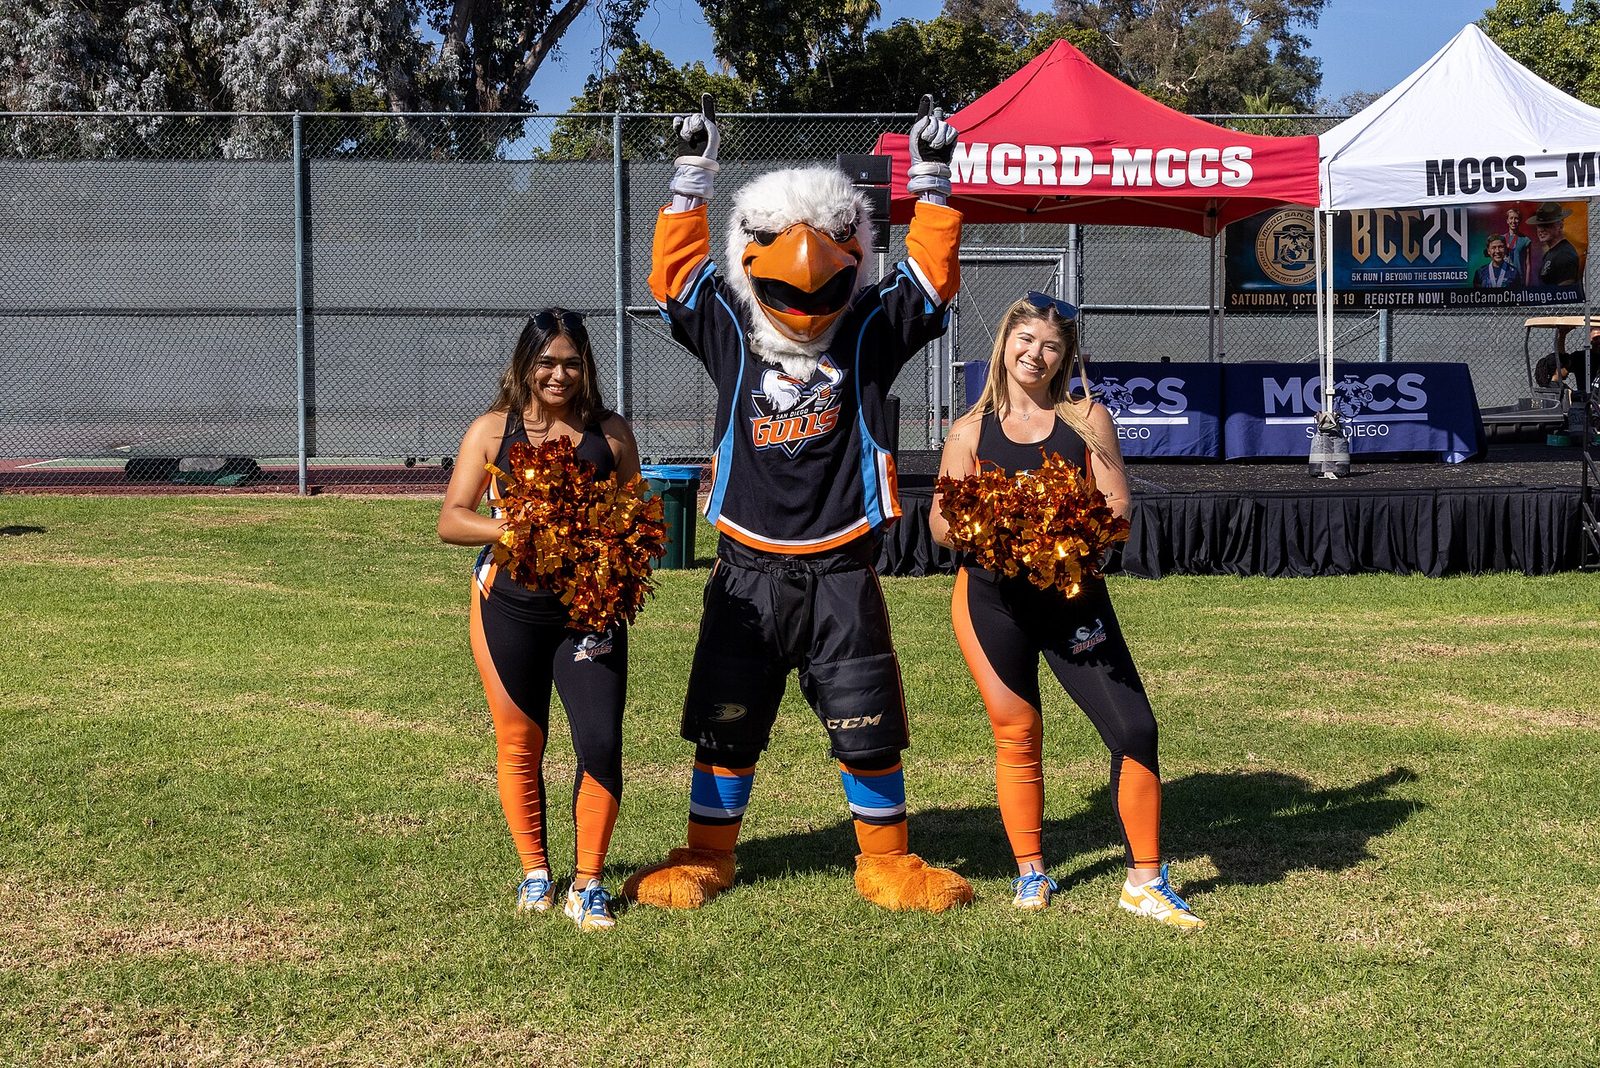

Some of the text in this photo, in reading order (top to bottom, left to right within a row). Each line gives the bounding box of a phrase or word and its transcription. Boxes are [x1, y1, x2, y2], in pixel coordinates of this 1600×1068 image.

[950, 142, 1253, 187] MCRD-MCCS
[1426, 155, 1527, 196] MCCS
[1566, 152, 1600, 188] M
[1270, 271, 1291, 282] CAMP
[1352, 273, 1361, 281] 5K
[1363, 273, 1378, 281] RUN
[1385, 273, 1413, 281] BEYOND
[1414, 272, 1427, 280] THE
[1428, 271, 1468, 280] OBSTACLES
[1231, 290, 1578, 306] SATURDAY, OCTOBR 19 REGISTER NOW! BootCampChallenge.com
[789, 408, 809, 418] DIEGO
[749, 405, 841, 448] GULLS
[826, 712, 884, 730] CCM
